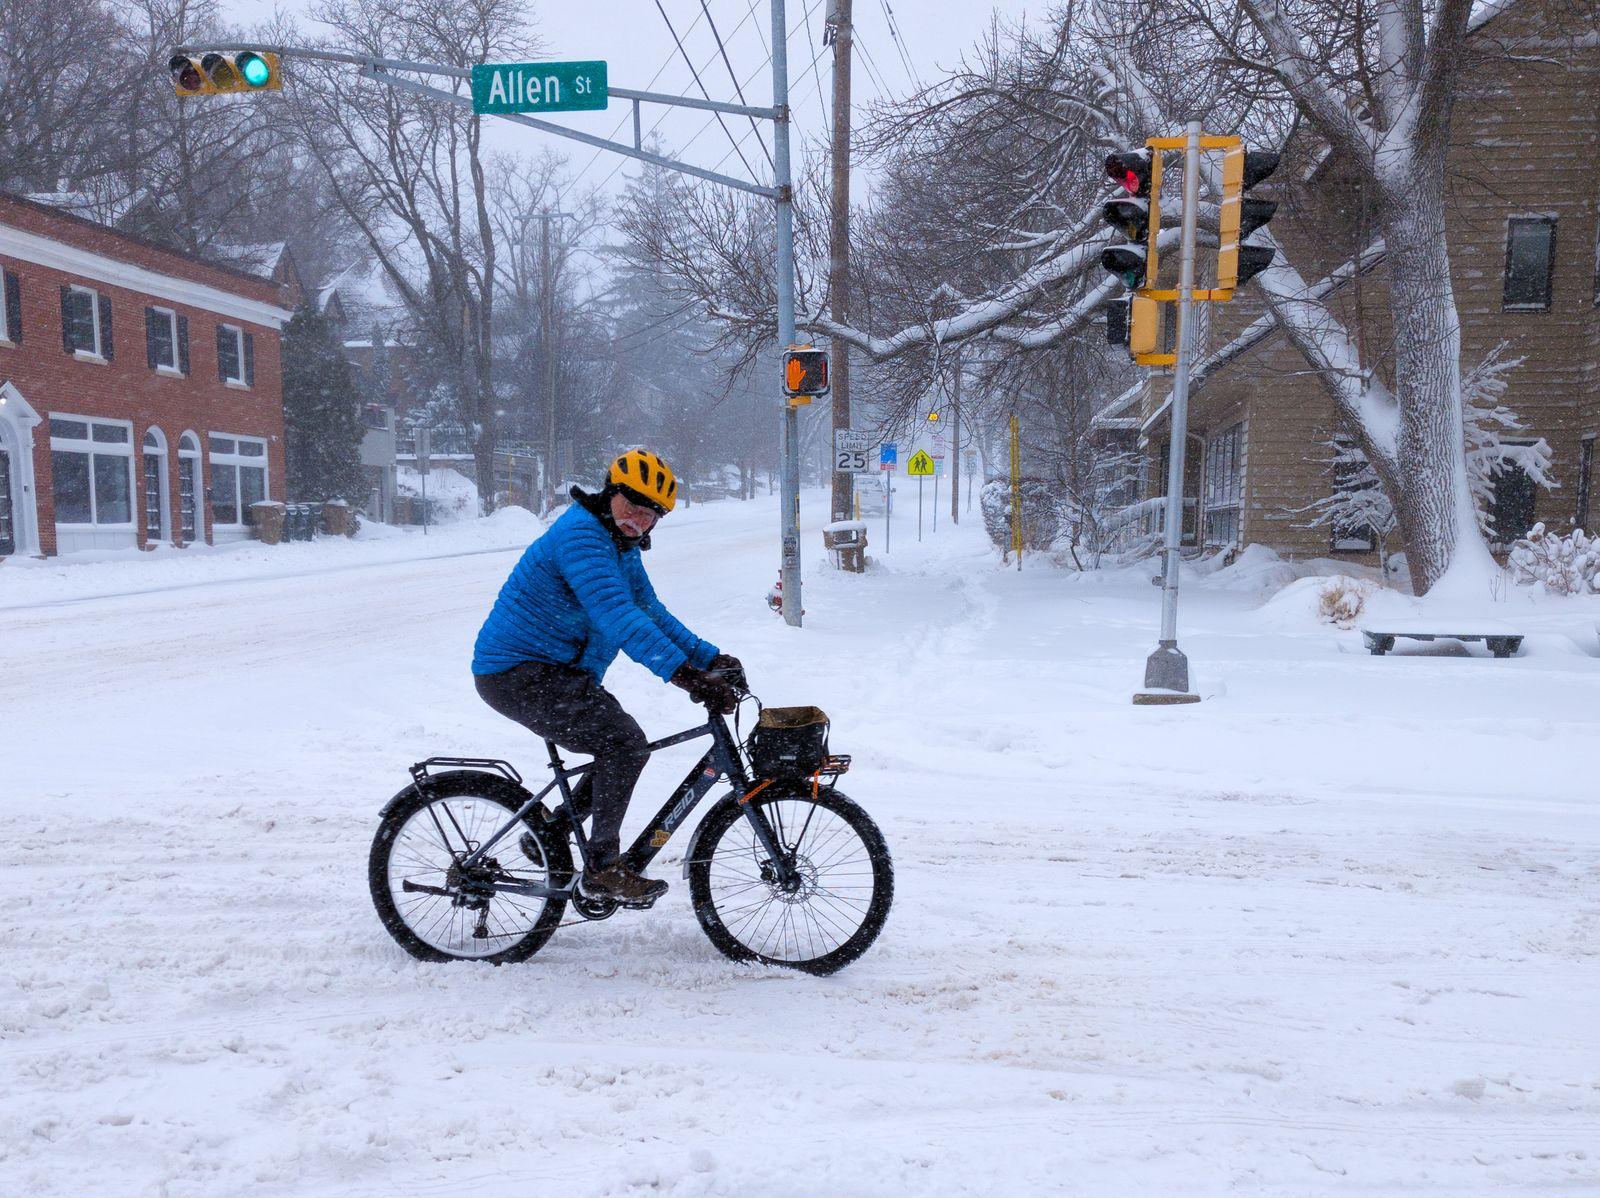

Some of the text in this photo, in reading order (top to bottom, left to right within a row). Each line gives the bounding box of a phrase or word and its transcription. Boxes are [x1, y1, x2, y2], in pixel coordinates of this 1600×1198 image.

[488, 70, 592, 104] Allen St
[838, 431, 867, 440] SPEED
[838, 453, 866, 469] 25
[663, 788, 695, 831] REID
